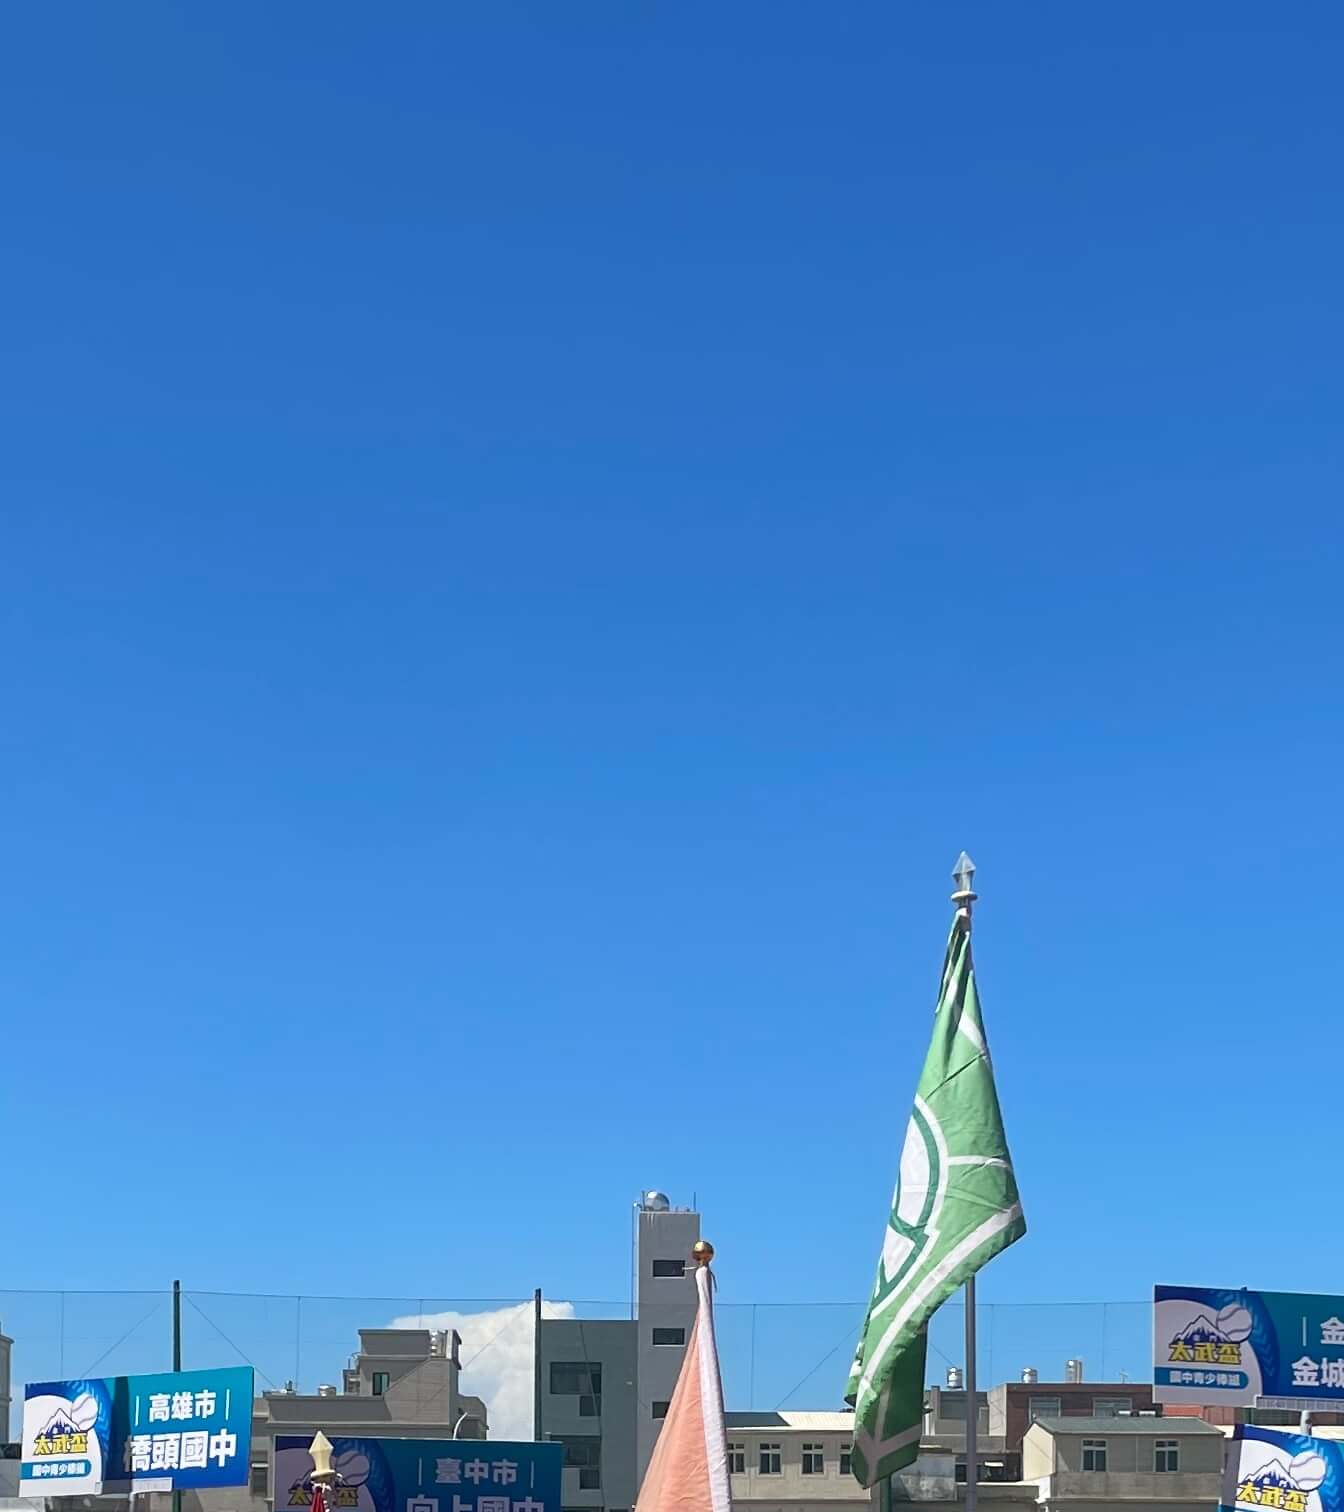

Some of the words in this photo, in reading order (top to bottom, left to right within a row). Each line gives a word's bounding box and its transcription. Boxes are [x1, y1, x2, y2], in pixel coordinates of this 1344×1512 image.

[1168, 1340, 1242, 1365] 太武盃
[149, 1389, 216, 1422] 高雄市
[34, 1431, 88, 1456] 太武盃
[124, 1428, 236, 1473] 橋頭國中
[434, 1458, 518, 1486] 臺中市
[288, 1486, 359, 1506] 太盃
